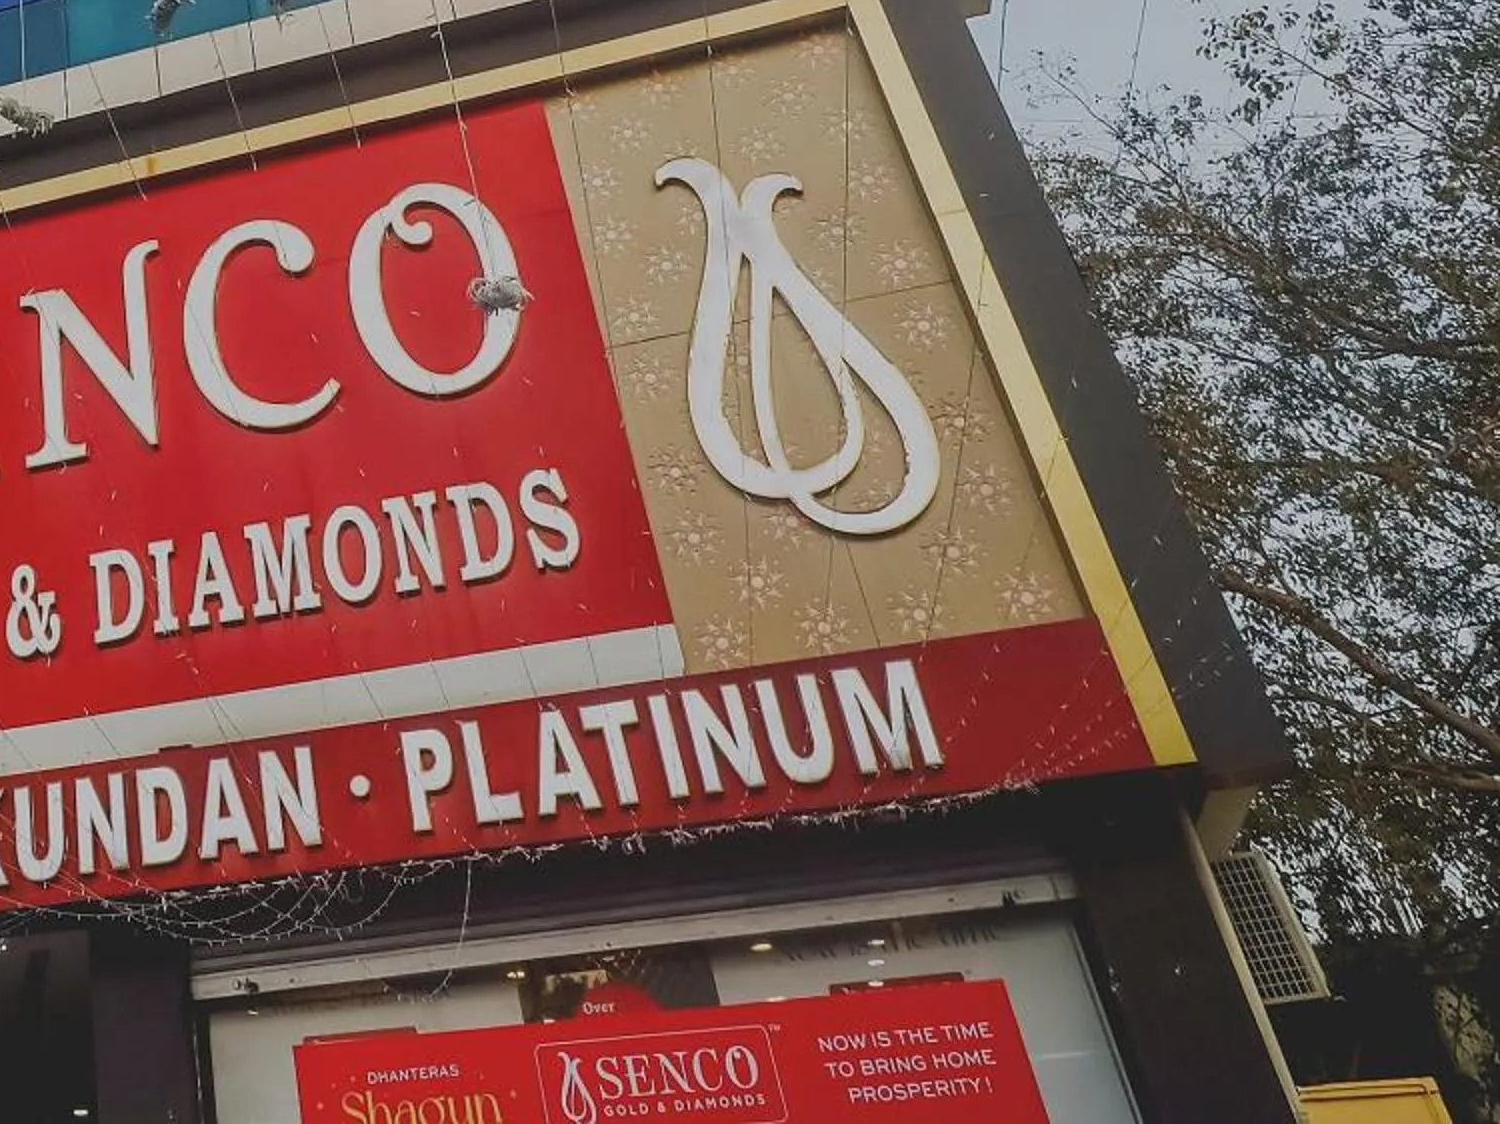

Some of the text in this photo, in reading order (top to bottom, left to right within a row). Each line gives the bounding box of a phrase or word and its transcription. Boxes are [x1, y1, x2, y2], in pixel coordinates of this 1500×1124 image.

[6, 564, 63, 660] &
[90, 467, 582, 647] DIAMONDS
[400, 659, 946, 833] PLATINUM
[583, 1002, 616, 1016] Over
[818, 1021, 994, 1053] NOW IS THE TIME
[367, 1064, 461, 1085] DHANTERAS
[596, 1045, 759, 1101] SENCO
[825, 1049, 997, 1079] TO BRING HOME
[604, 1093, 766, 1117] GOLD & DIAMONDS
